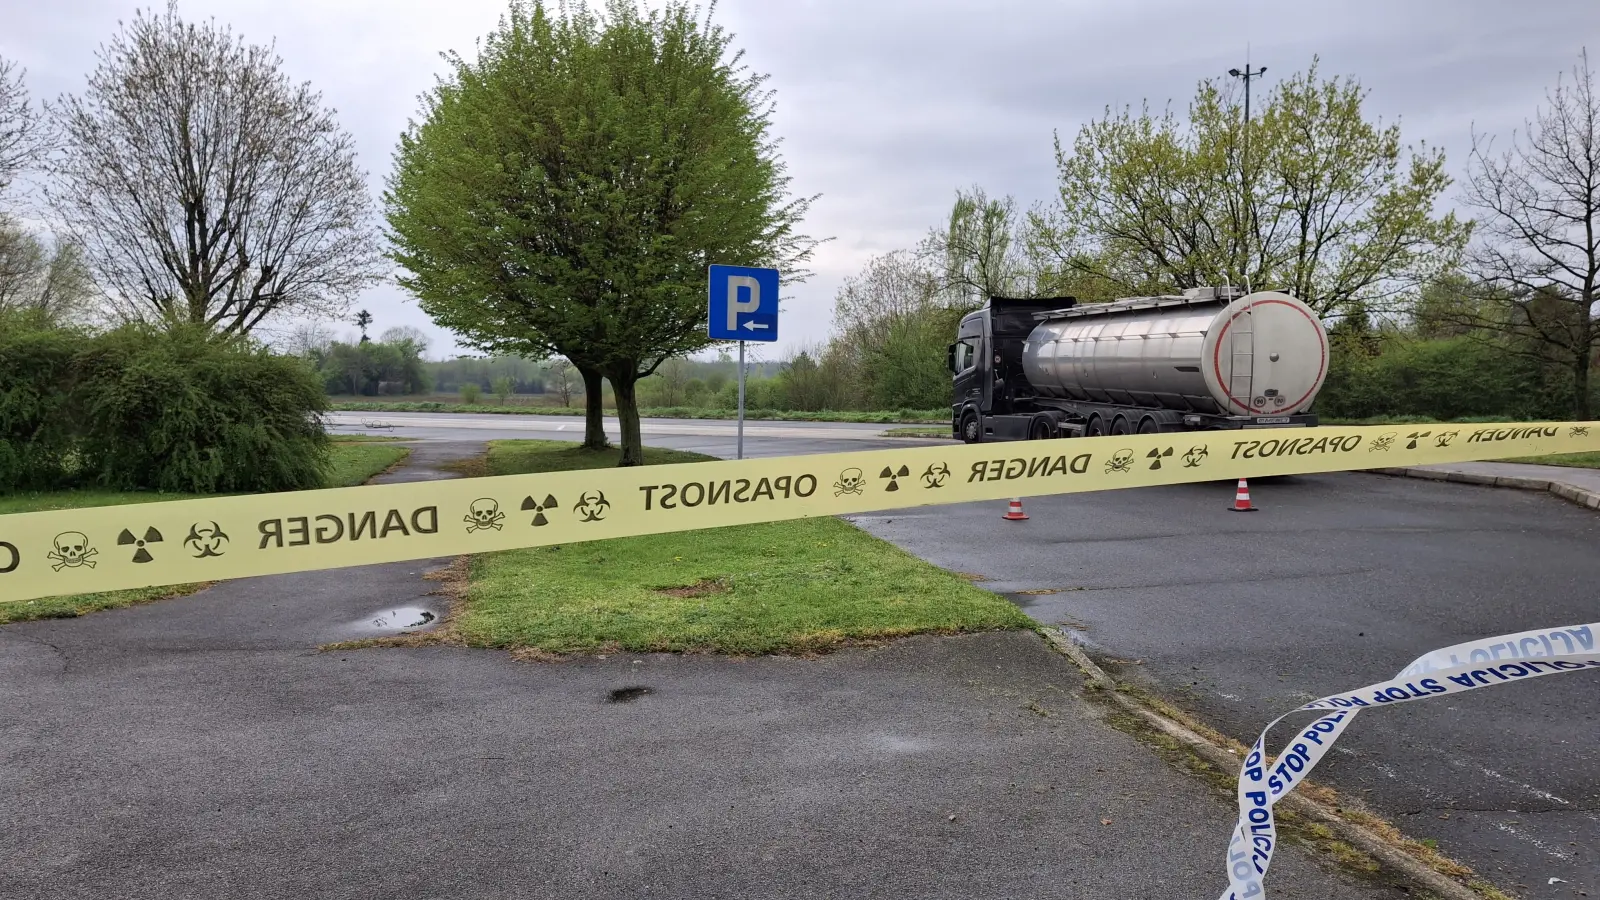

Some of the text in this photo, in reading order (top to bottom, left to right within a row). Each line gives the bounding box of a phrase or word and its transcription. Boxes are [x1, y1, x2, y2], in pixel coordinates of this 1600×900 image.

[727, 275, 760, 331] P
[1374, 678, 1447, 703] STOP
[1268, 743, 1311, 795] STOP
[1245, 791, 1272, 875] POLICIJ
